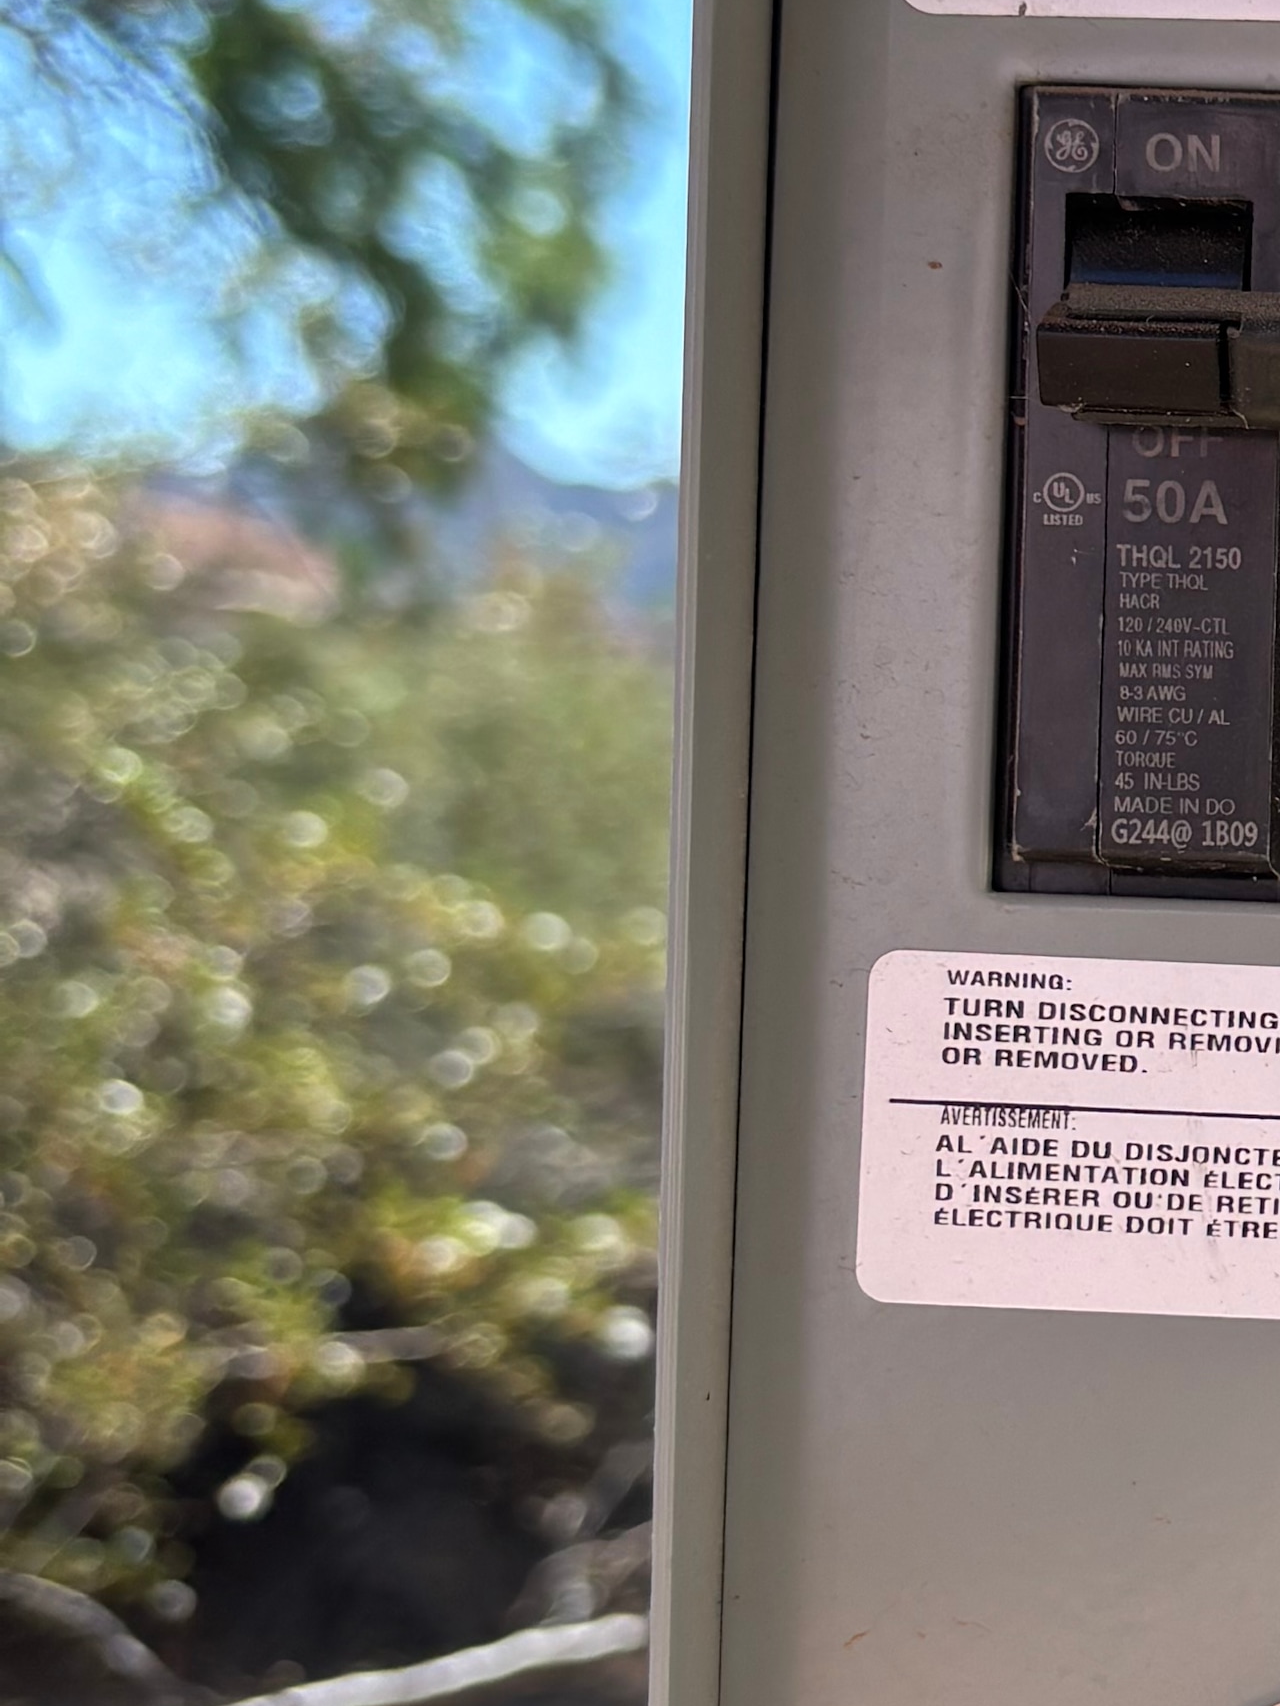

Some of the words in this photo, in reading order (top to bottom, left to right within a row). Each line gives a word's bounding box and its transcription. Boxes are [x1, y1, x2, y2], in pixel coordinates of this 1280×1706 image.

[1145, 132, 1221, 173] ON
[1124, 479, 1228, 524] 50A
[1043, 514, 1083, 525] LISTED
[1116, 544, 1181, 572] THQL
[1189, 546, 1241, 569] 2150
[1122, 572, 1160, 589] TYPE
[1169, 574, 1208, 590] THQL
[1120, 593, 1159, 609] HACR
[1118, 616, 1143, 632] 120
[1118, 640, 1131, 656] 10
[1136, 639, 1153, 657] KA
[1158, 639, 1177, 657] INT
[1184, 640, 1233, 659] RATING
[1147, 685, 1186, 701] AWG
[1117, 706, 1162, 723] WIRE
[1168, 708, 1193, 725] CU
[1208, 709, 1230, 725] AL
[1115, 730, 1137, 744] 60
[1116, 750, 1175, 768] TORQUE
[1115, 772, 1134, 789] 45
[1145, 773, 1200, 791] IN-LBS
[1114, 796, 1172, 814] MADE
[1180, 798, 1199, 814] IN
[1206, 799, 1235, 815] DO
[946, 969, 1072, 991] WARNING:
[943, 997, 1025, 1019] TURN
[1038, 1001, 1279, 1030] DISCONNECTING
[943, 1021, 1103, 1047] INSERTING
[1115, 1029, 1155, 1049] OR
[941, 1046, 982, 1066] OR
[994, 1048, 1148, 1074] REMOVED.
